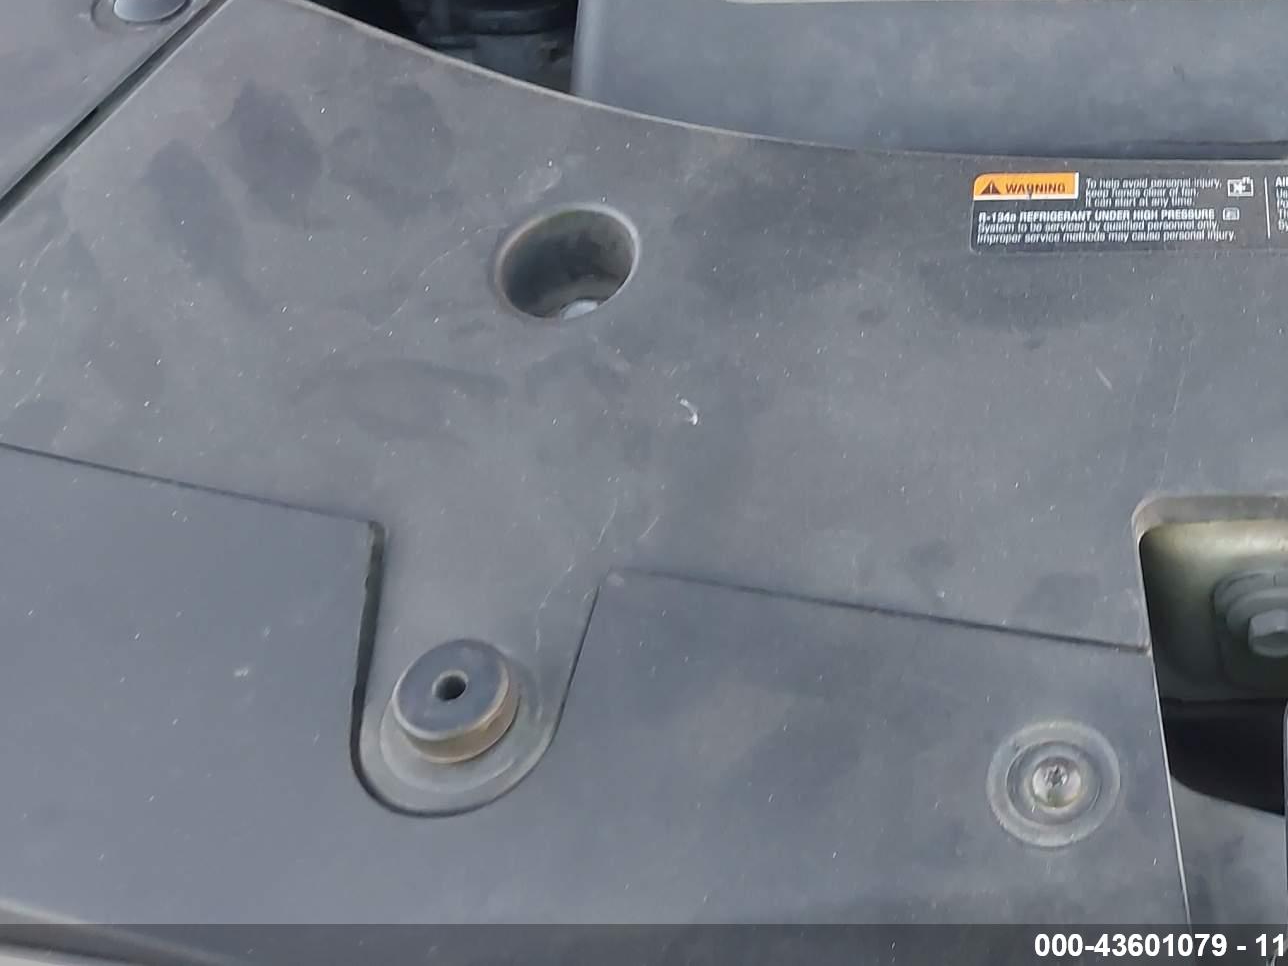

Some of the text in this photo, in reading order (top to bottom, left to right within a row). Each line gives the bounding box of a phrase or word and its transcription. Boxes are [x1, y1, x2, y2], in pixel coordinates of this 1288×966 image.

[1005, 182, 1066, 194] WARNING
[1099, 178, 1116, 190] help
[1122, 178, 1148, 189] avoid
[1150, 178, 1191, 191] personal
[1094, 198, 1112, 207] can
[1114, 197, 1137, 207] start
[1150, 197, 1169, 208] any
[1019, 210, 1092, 223] REFRIGERANT
[1094, 209, 1130, 222] UNDER
[1133, 209, 1159, 221] HIGH
[1161, 208, 1215, 221] PRESSURE
[978, 222, 1015, 234] System
[1018, 222, 1028, 233] to
[1030, 221, 1042, 233] be
[1045, 221, 1085, 232] serviced
[1088, 220, 1101, 234] by
[1103, 220, 1144, 232] qualified
[1147, 220, 1195, 232] personnel
[977, 232, 1021, 245] Improper
[1024, 232, 1060, 243] service
[1063, 231, 1106, 243] methods
[1108, 232, 1129, 243] may
[1131, 231, 1161, 242] cause
[1163, 230, 1205, 242] personal
